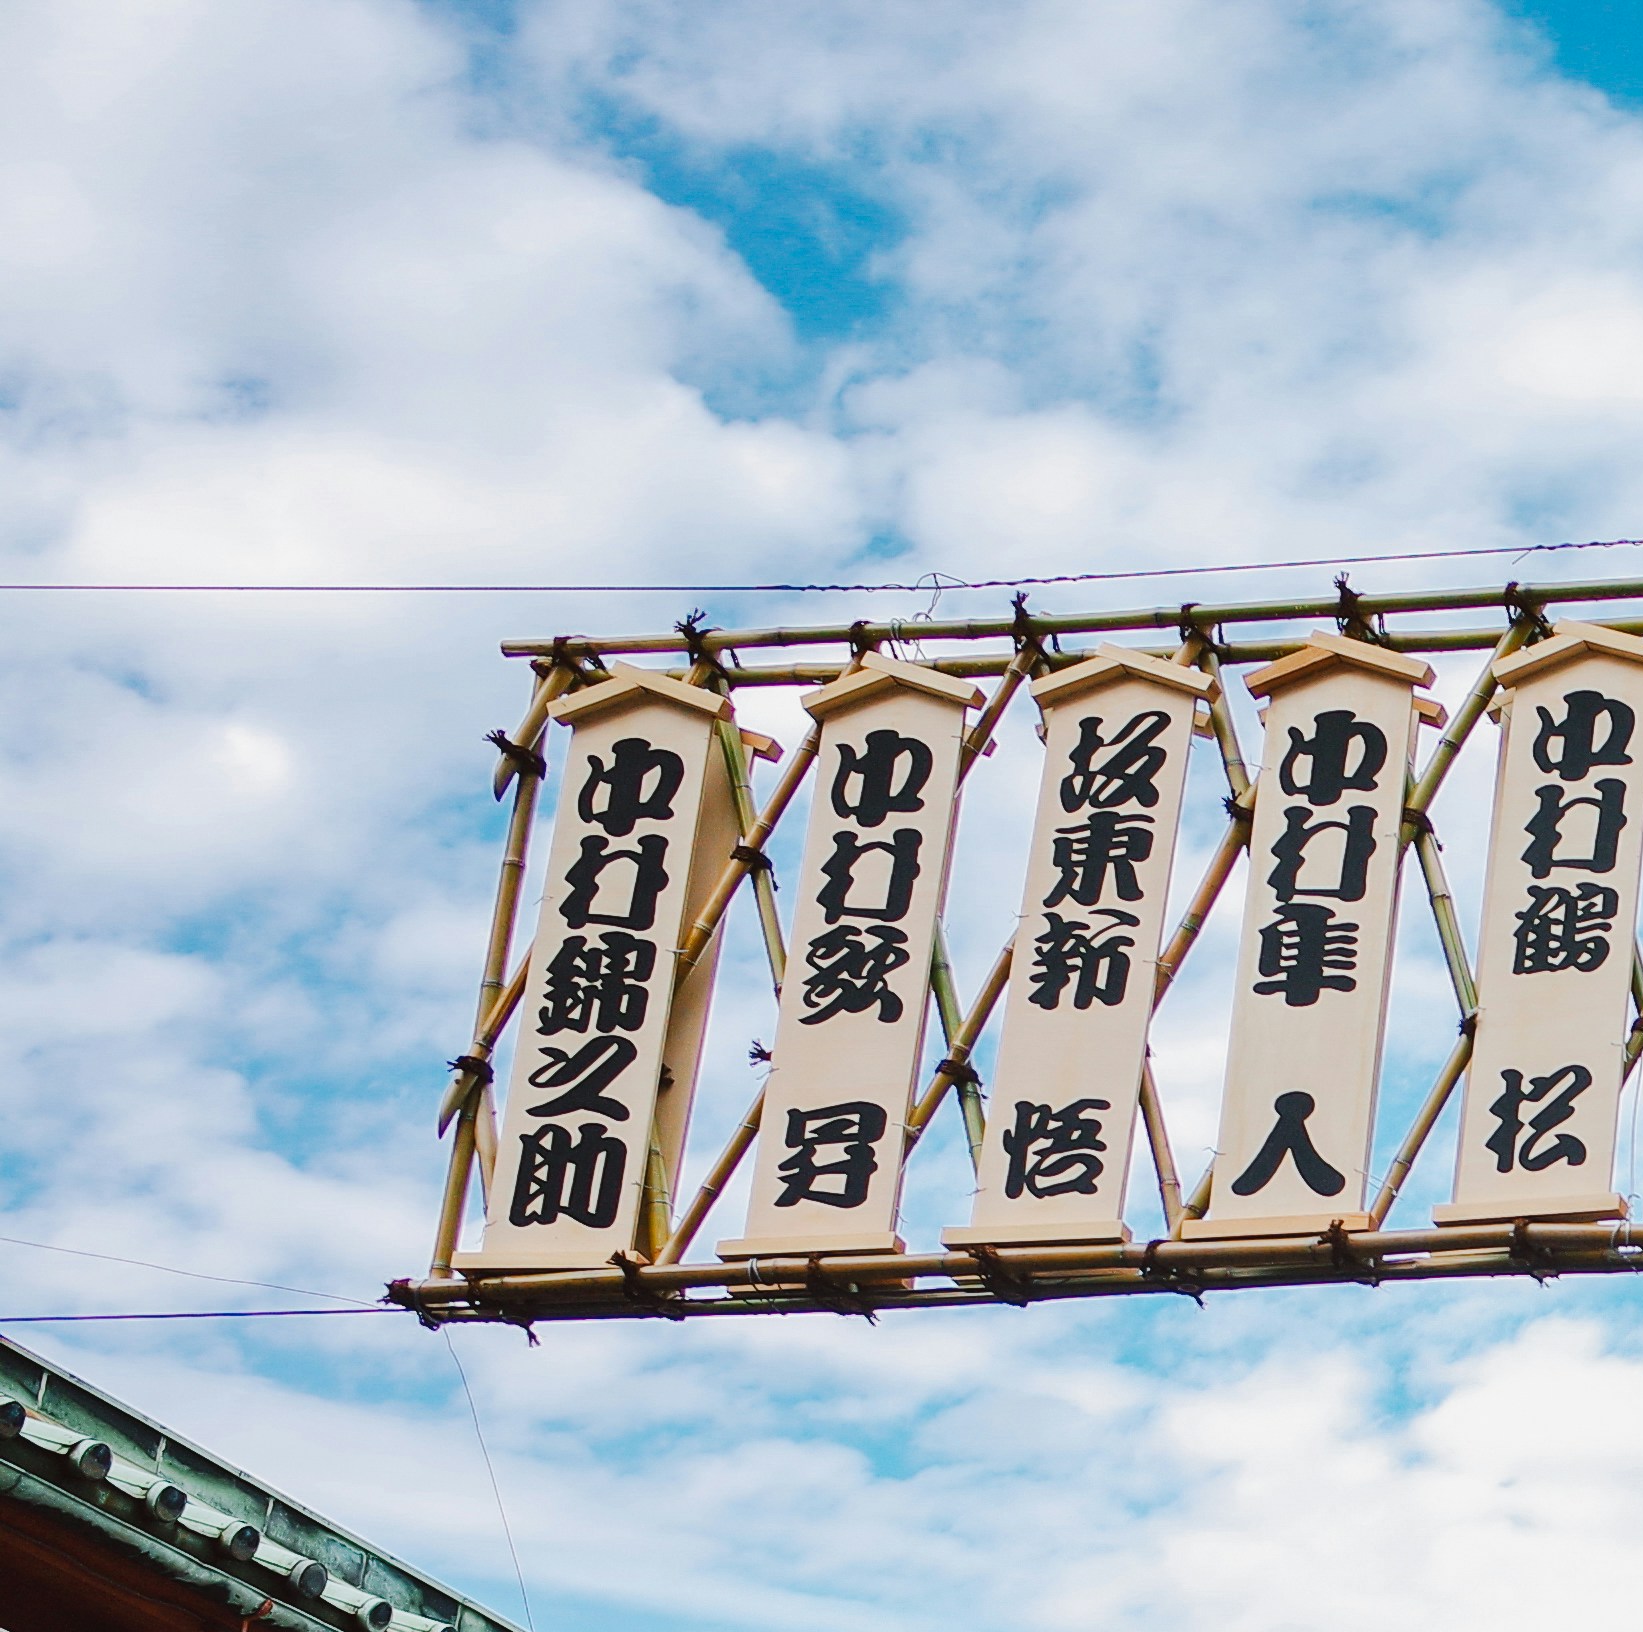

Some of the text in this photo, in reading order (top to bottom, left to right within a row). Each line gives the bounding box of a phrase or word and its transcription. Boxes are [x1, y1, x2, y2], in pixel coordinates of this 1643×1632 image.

[513, 737, 685, 1230] 中村錦之助
[774, 729, 933, 1209] 中村歌昇
[1231, 709, 1389, 1198] 中村隼人
[1487, 688, 1637, 1175] 中村鶴松
